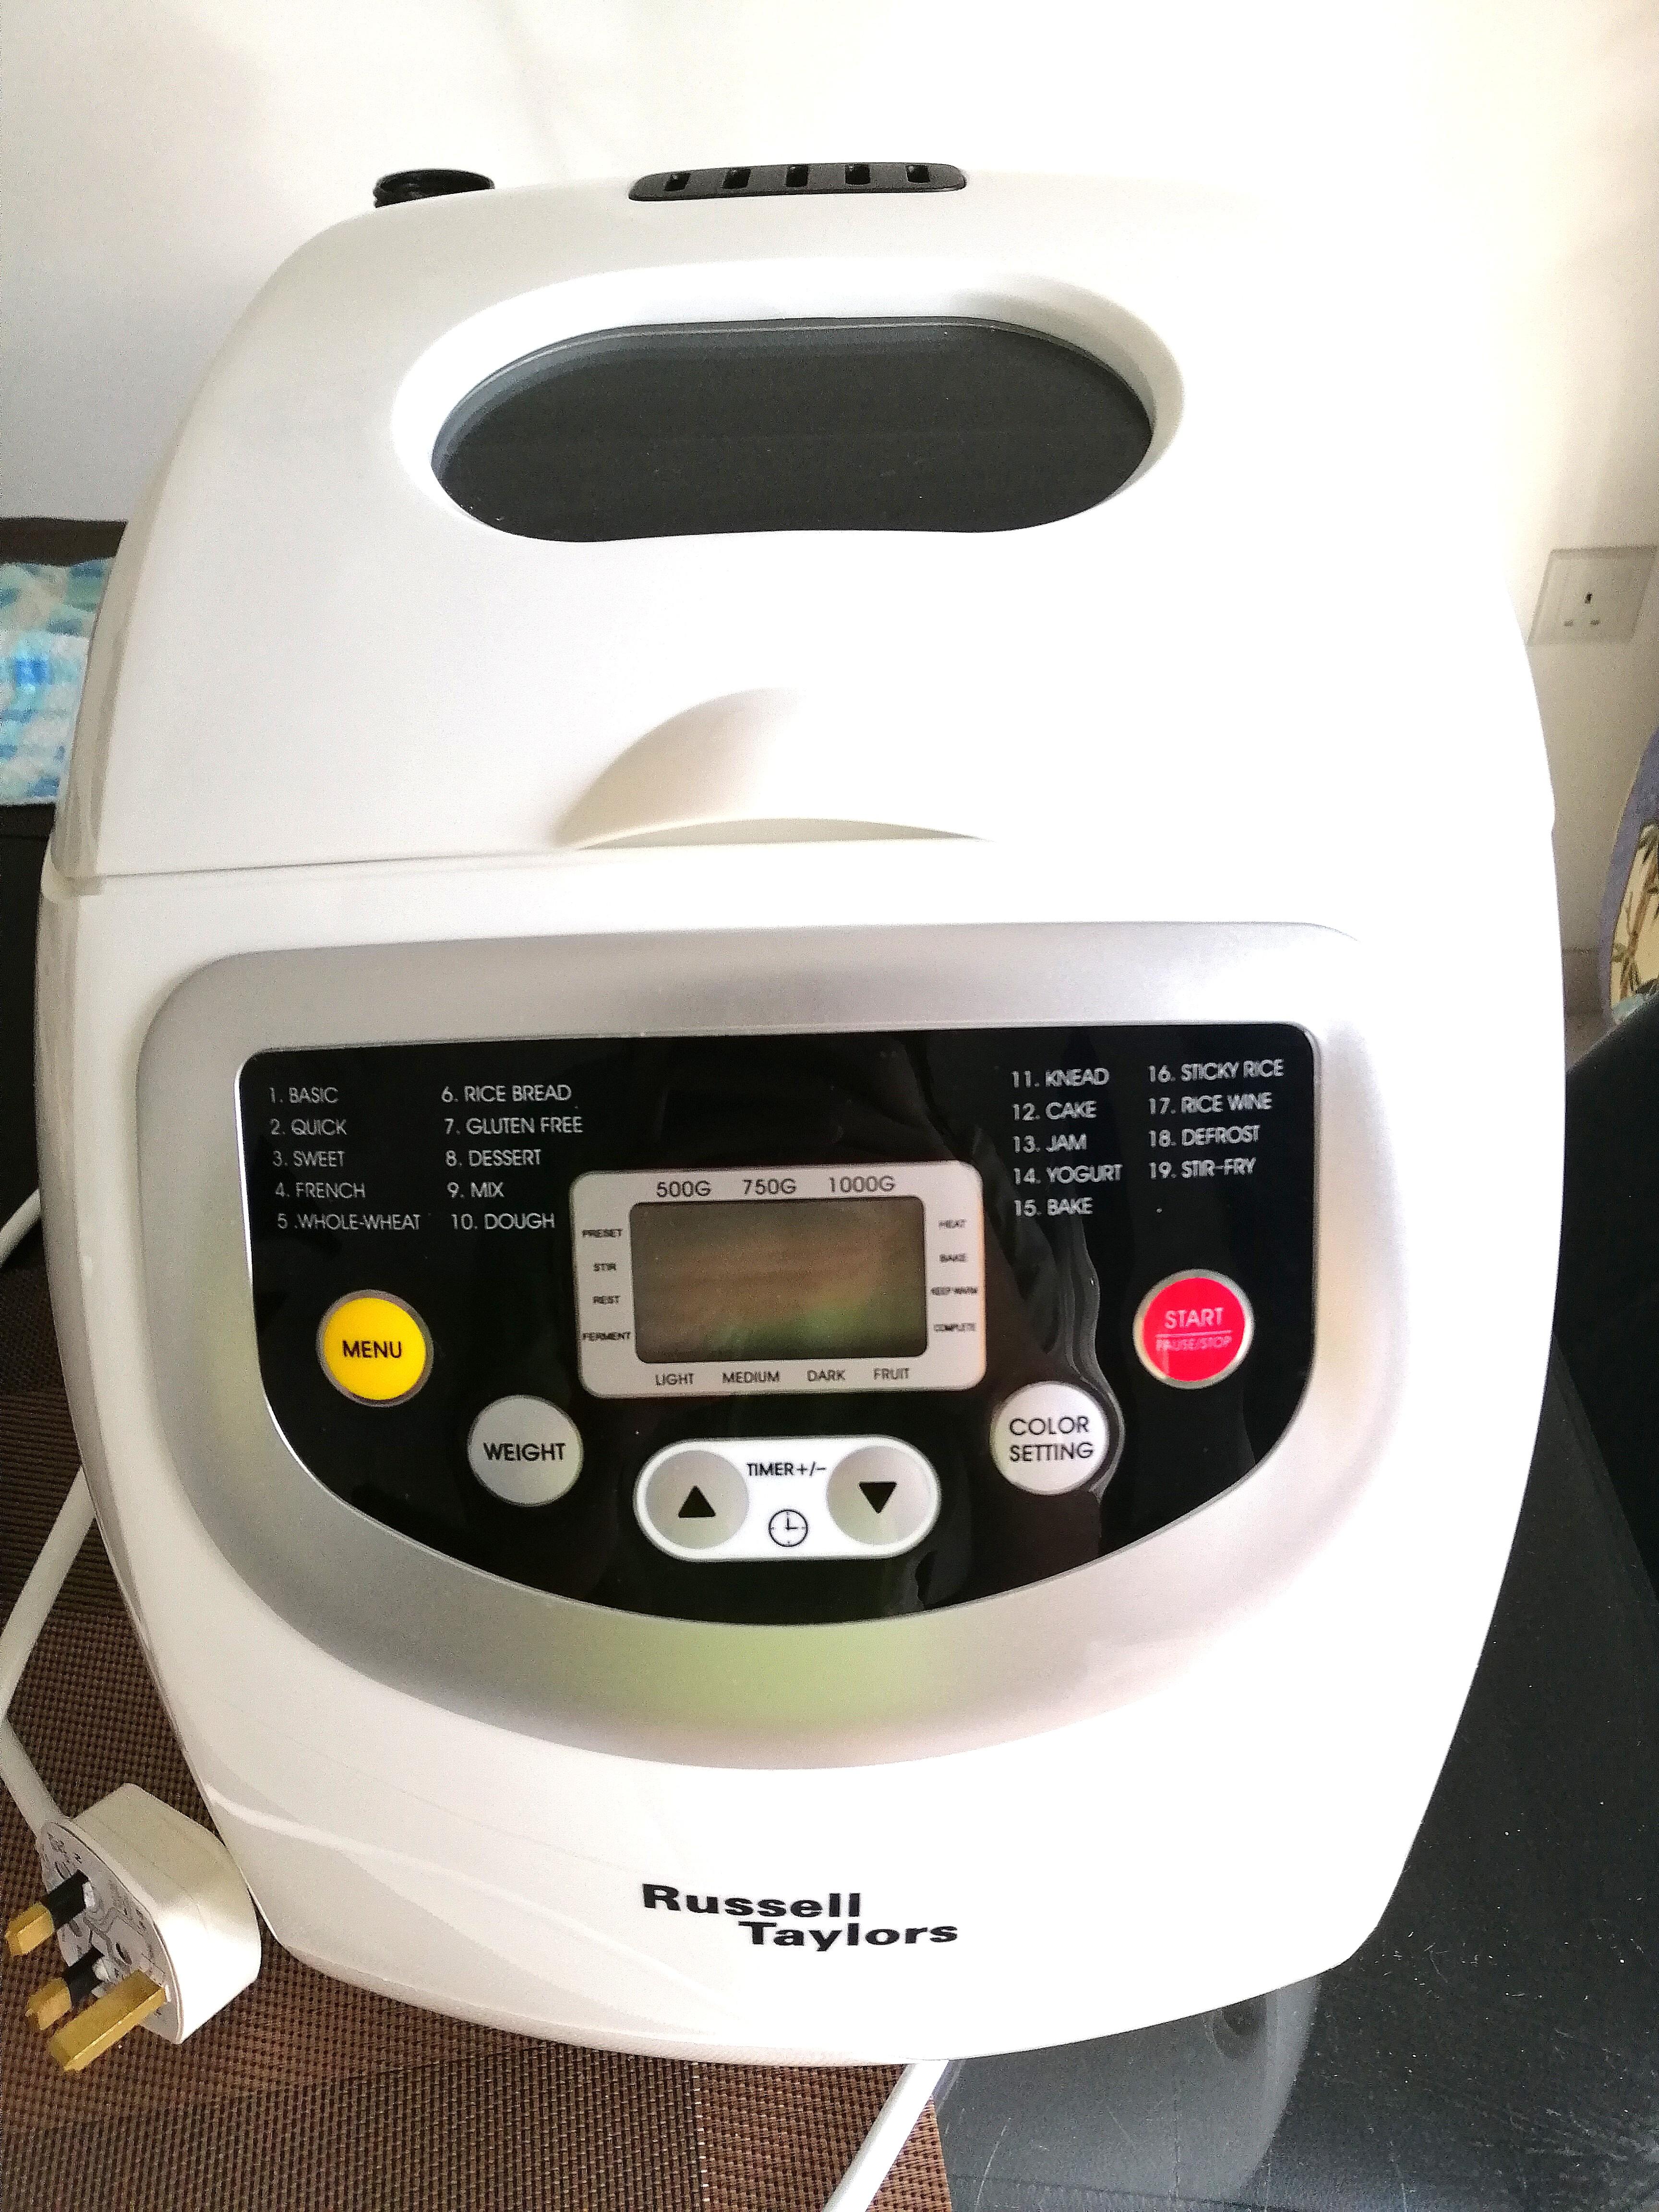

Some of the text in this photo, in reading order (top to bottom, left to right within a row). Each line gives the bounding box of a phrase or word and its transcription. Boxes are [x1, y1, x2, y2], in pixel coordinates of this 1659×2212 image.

[1012, 1068, 1110, 1088] 11. KNEAD
[1148, 1059, 1284, 1083] 16. STICKY RICE
[269, 1087, 339, 1104] 1. BASIC
[442, 1084, 572, 1103] 6. RICE BREAD
[1148, 1092, 1273, 1115] 17. RICE WINE
[1012, 1101, 1097, 1121] 12. CAKE
[270, 1118, 348, 1136] 2. QUICK
[444, 1117, 583, 1134] 7. GLUTEN FREE
[1013, 1134, 1087, 1153] 13. JAM
[1148, 1125, 1261, 1148] 18. DEFROST
[273, 1150, 345, 1167] 3. SWEET
[445, 1149, 541, 1166] 8. DESSERT
[1013, 1164, 1123, 1185] 14. YOGURT
[1149, 1157, 1256, 1179] 19. STIR-FRY
[275, 1182, 365, 1198] 4. FRENCH
[447, 1182, 505, 1198] 9. MIX
[656, 1176, 895, 1197] 500G 750G 1000G
[1014, 1197, 1093, 1217] 15. BAKE
[452, 1213, 555, 1230] 10. DOUGH
[1165, 1307, 1224, 1329] START
[342, 1340, 402, 1358] MENU
[655, 1367, 910, 1387] LIGHT MEDIUM DARK FRUIT
[1009, 1416, 1090, 1436] COLOR
[483, 1442, 566, 1461] WEIGHT
[1009, 1443, 1094, 1463] SETTING
[642, 1883, 861, 1918] Russell
[738, 1921, 958, 1952] Taylors
